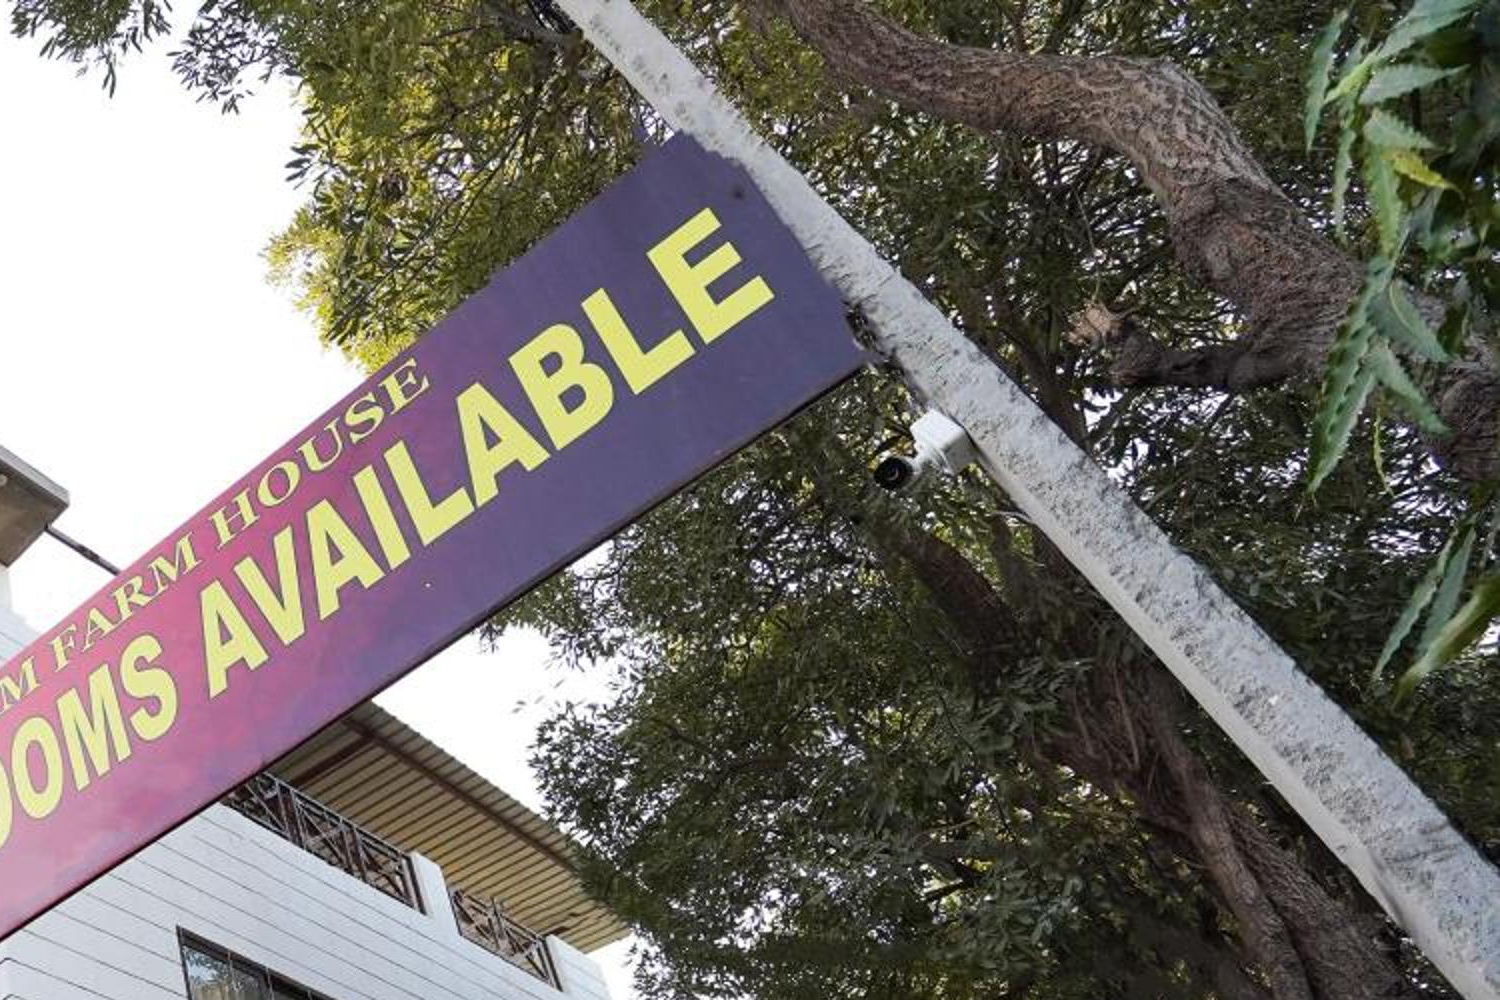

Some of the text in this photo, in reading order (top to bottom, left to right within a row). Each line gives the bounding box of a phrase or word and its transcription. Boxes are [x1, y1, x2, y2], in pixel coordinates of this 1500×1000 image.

[51, 532, 202, 672] FARM
[208, 357, 432, 549] HOUSE
[199, 206, 776, 699] AVAILABLE
